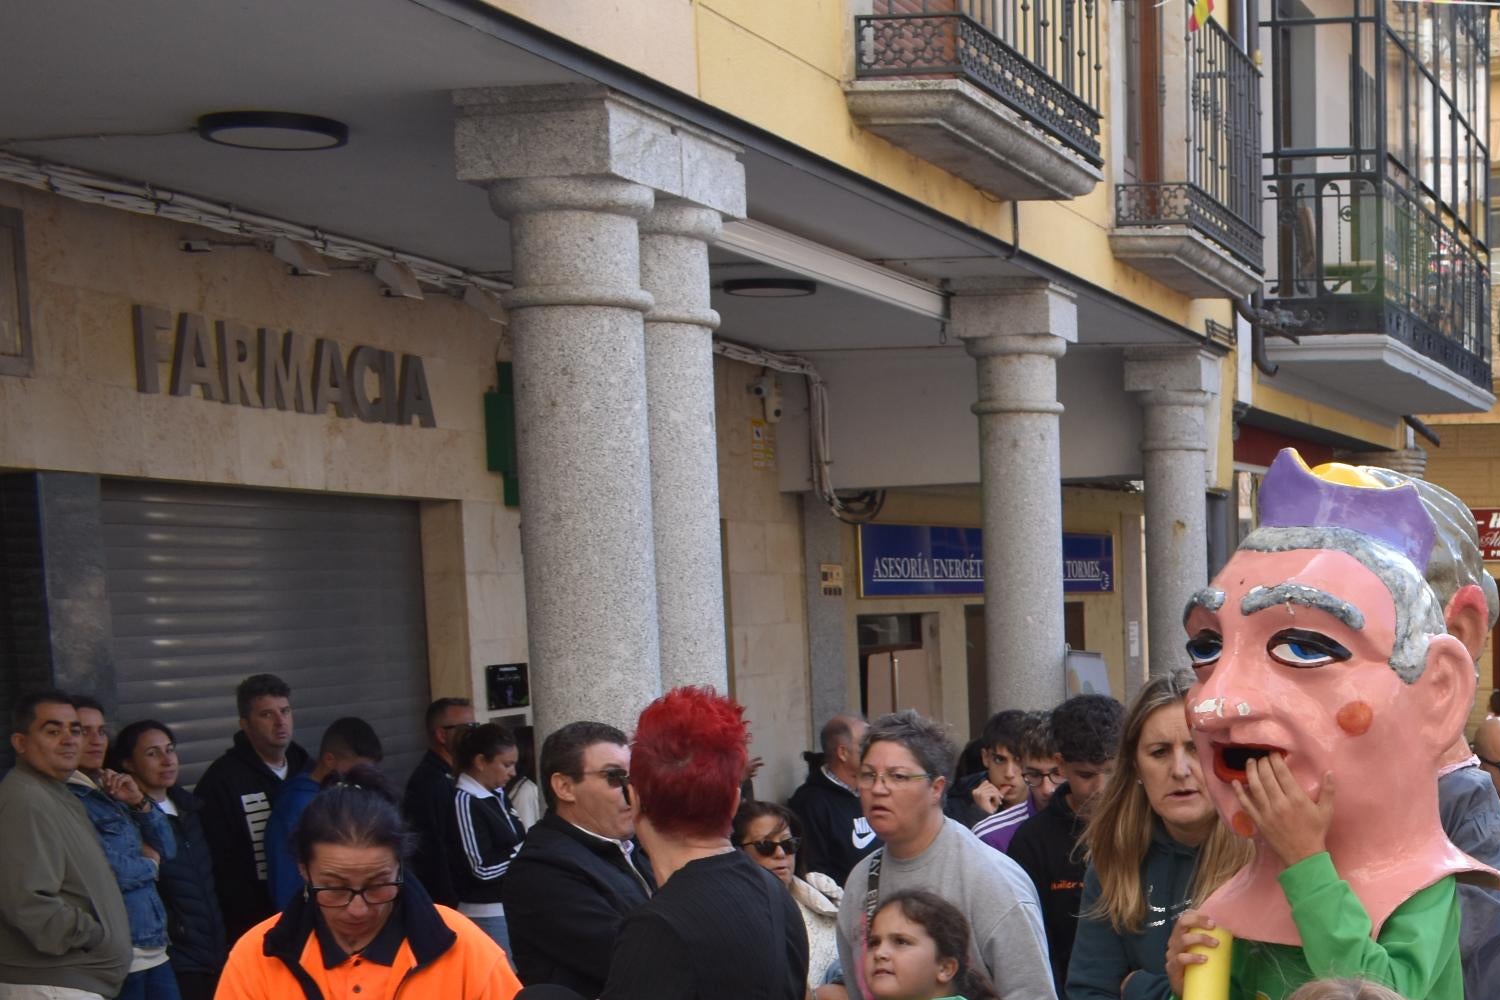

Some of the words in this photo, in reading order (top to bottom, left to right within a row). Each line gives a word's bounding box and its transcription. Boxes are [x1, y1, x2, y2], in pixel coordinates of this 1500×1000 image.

[131, 304, 437, 428] FARMACIA
[872, 552, 931, 578] ASESORÍA
[932, 554, 984, 578] ENERGÉT
[1066, 560, 1101, 578] TORMES
